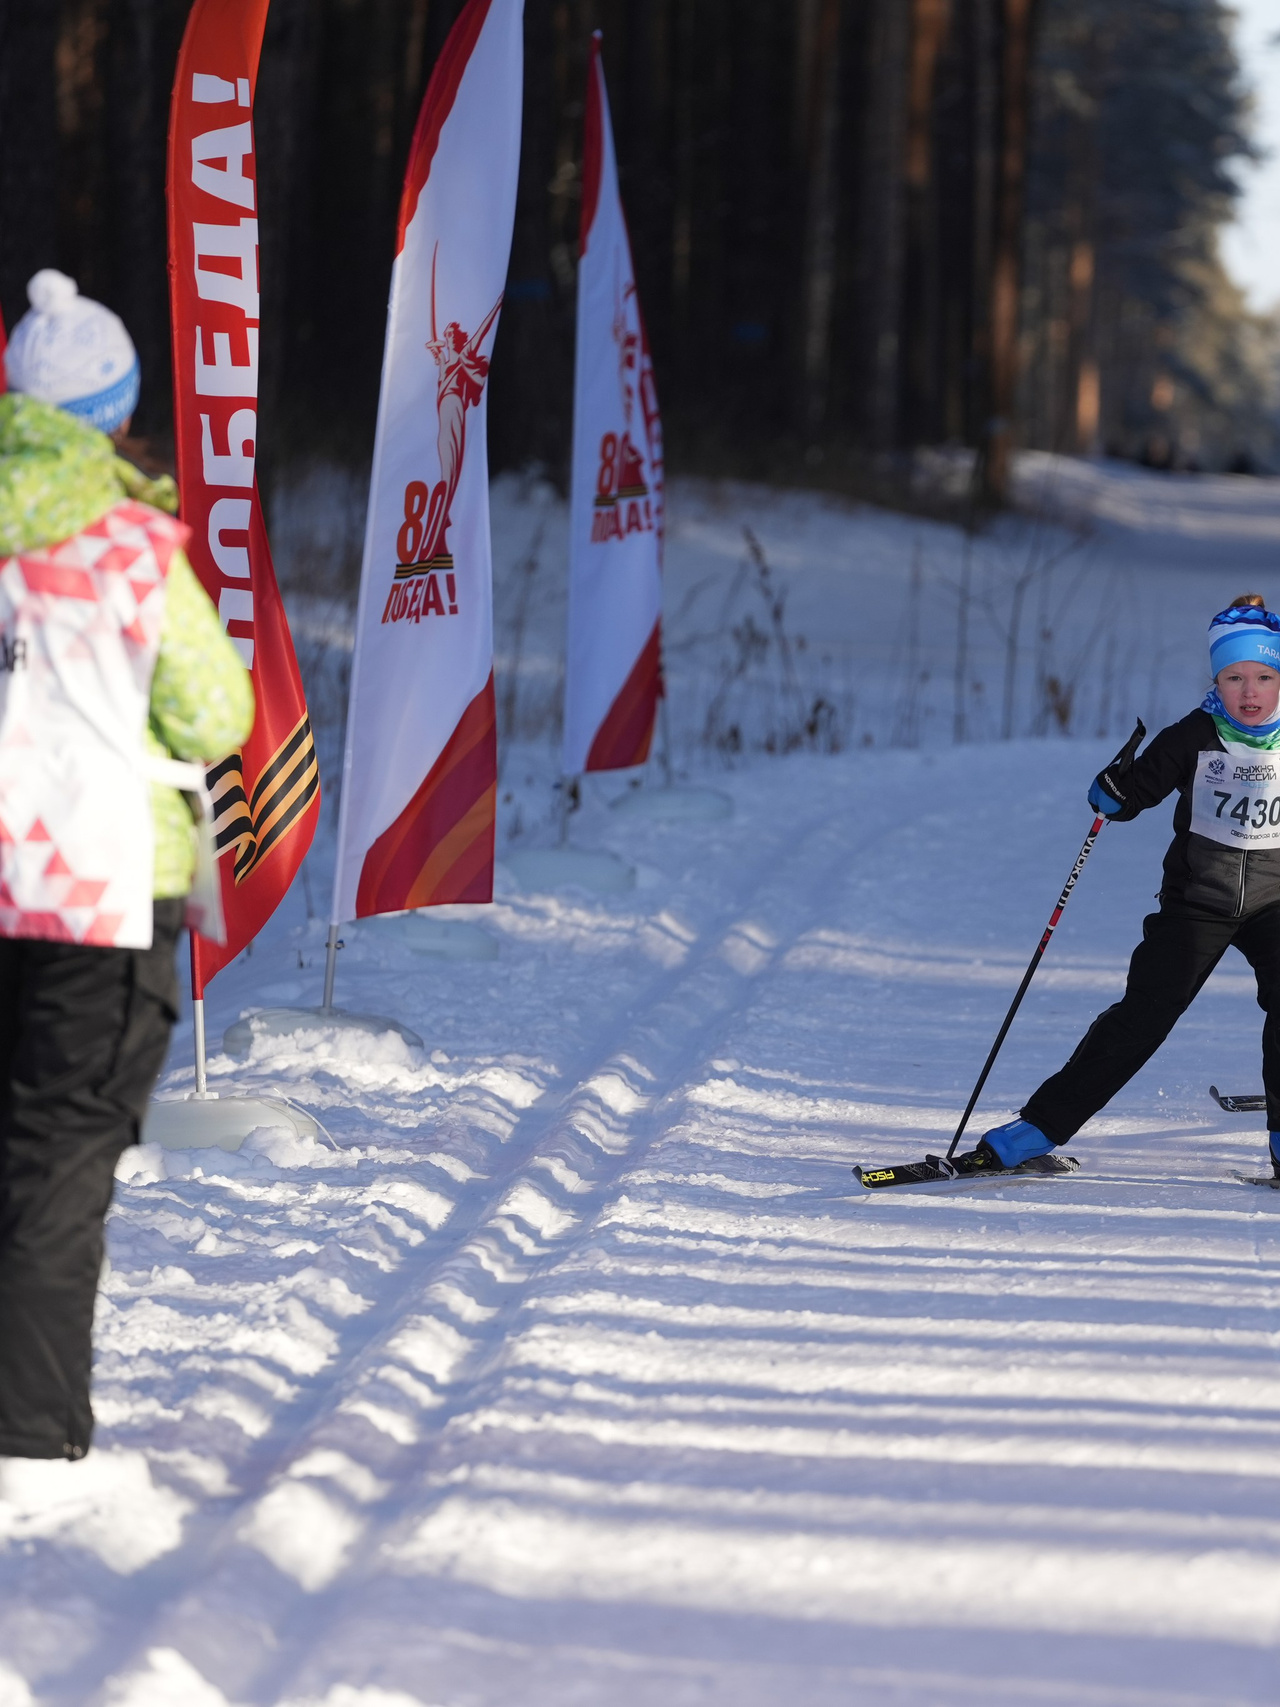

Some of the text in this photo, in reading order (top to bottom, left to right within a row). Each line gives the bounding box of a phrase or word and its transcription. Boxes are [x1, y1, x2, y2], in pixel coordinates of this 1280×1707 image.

[396, 480, 448, 564] 80
[1235, 765, 1275, 774] ЛЫЖНЯ
[1233, 772, 1278, 782] РОССИИ
[1230, 829, 1271, 841] СВЕРДЛОВСКАЯ
